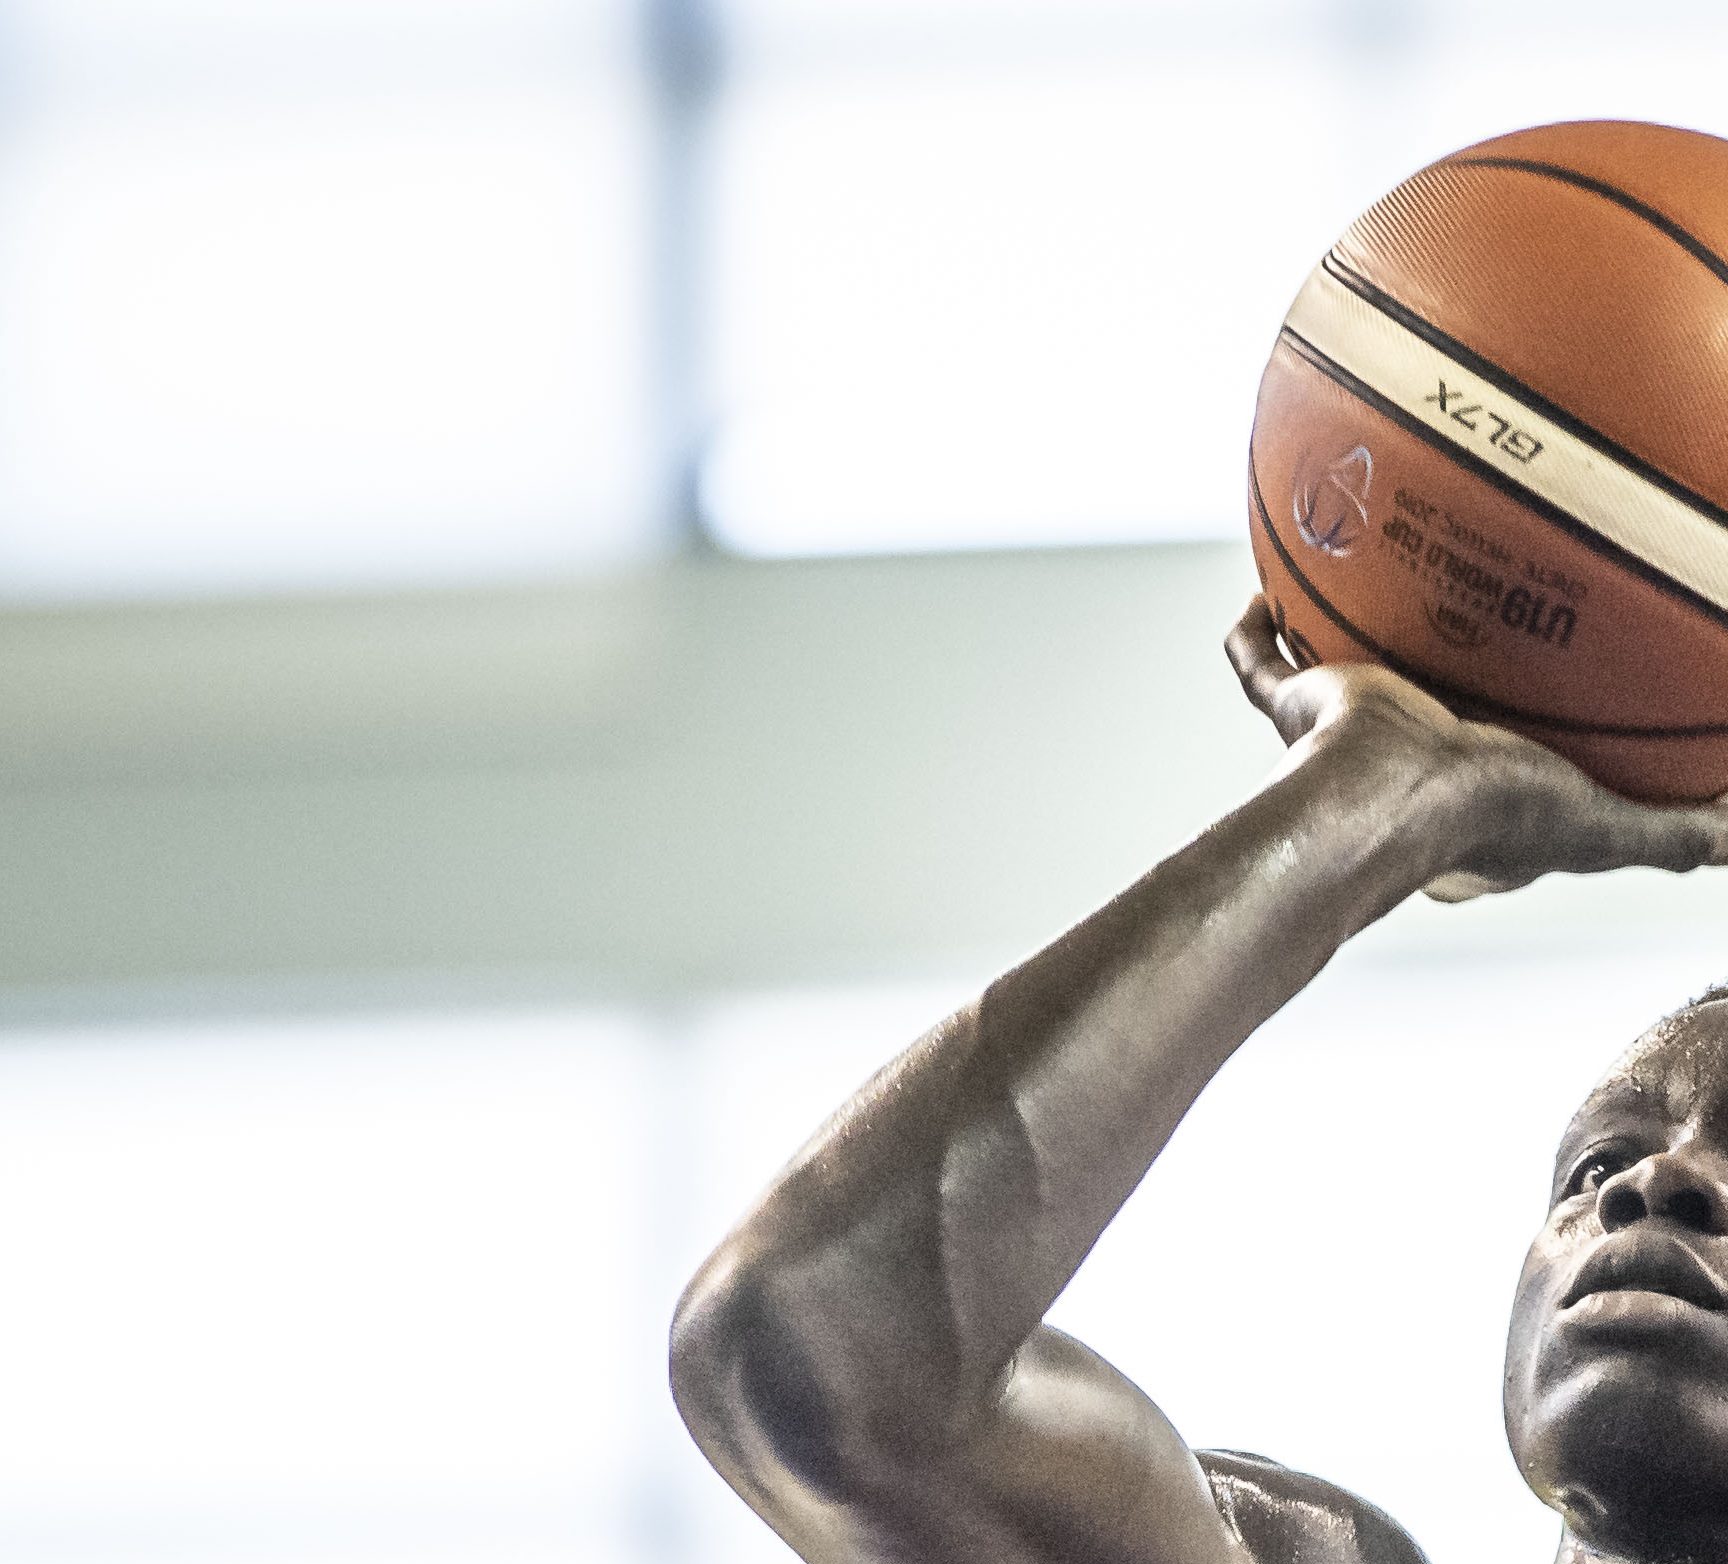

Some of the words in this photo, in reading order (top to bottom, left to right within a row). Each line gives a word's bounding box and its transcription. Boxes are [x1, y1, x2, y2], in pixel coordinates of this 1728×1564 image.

[1424, 378, 1544, 465] GL7X
[1424, 543, 1504, 600] WORLD
[1501, 585, 1578, 649] U19
